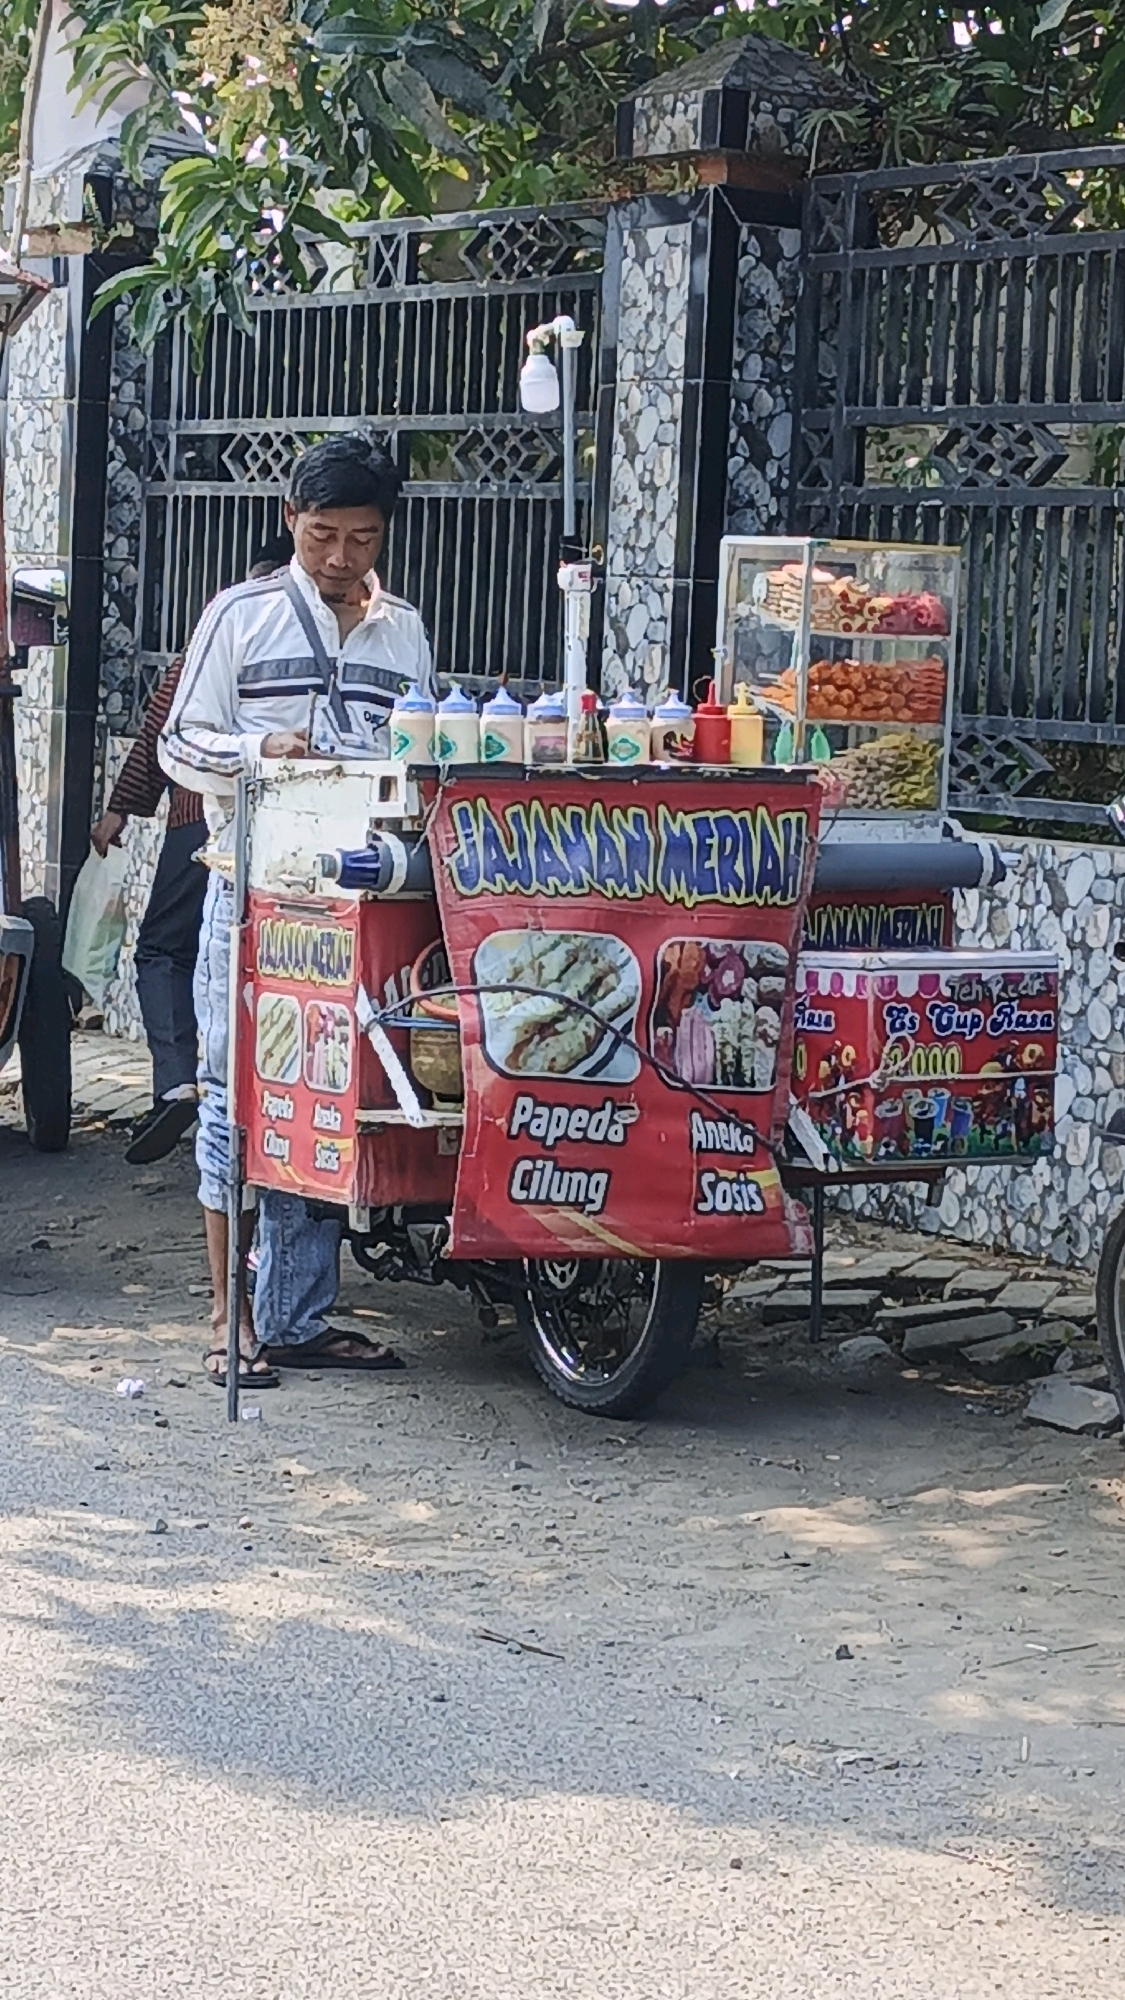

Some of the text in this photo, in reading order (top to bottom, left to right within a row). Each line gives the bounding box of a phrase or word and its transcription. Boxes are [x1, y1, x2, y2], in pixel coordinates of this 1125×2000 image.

[448, 798, 807, 906] JAJANAN MERIAH
[885, 1001, 1054, 1040] Es Cup Rasa
[510, 1096, 627, 1146] Papeda
[691, 1112, 755, 1153] Aneka
[510, 1159, 609, 1214] Cilung
[696, 1172, 765, 1213] Sosis
